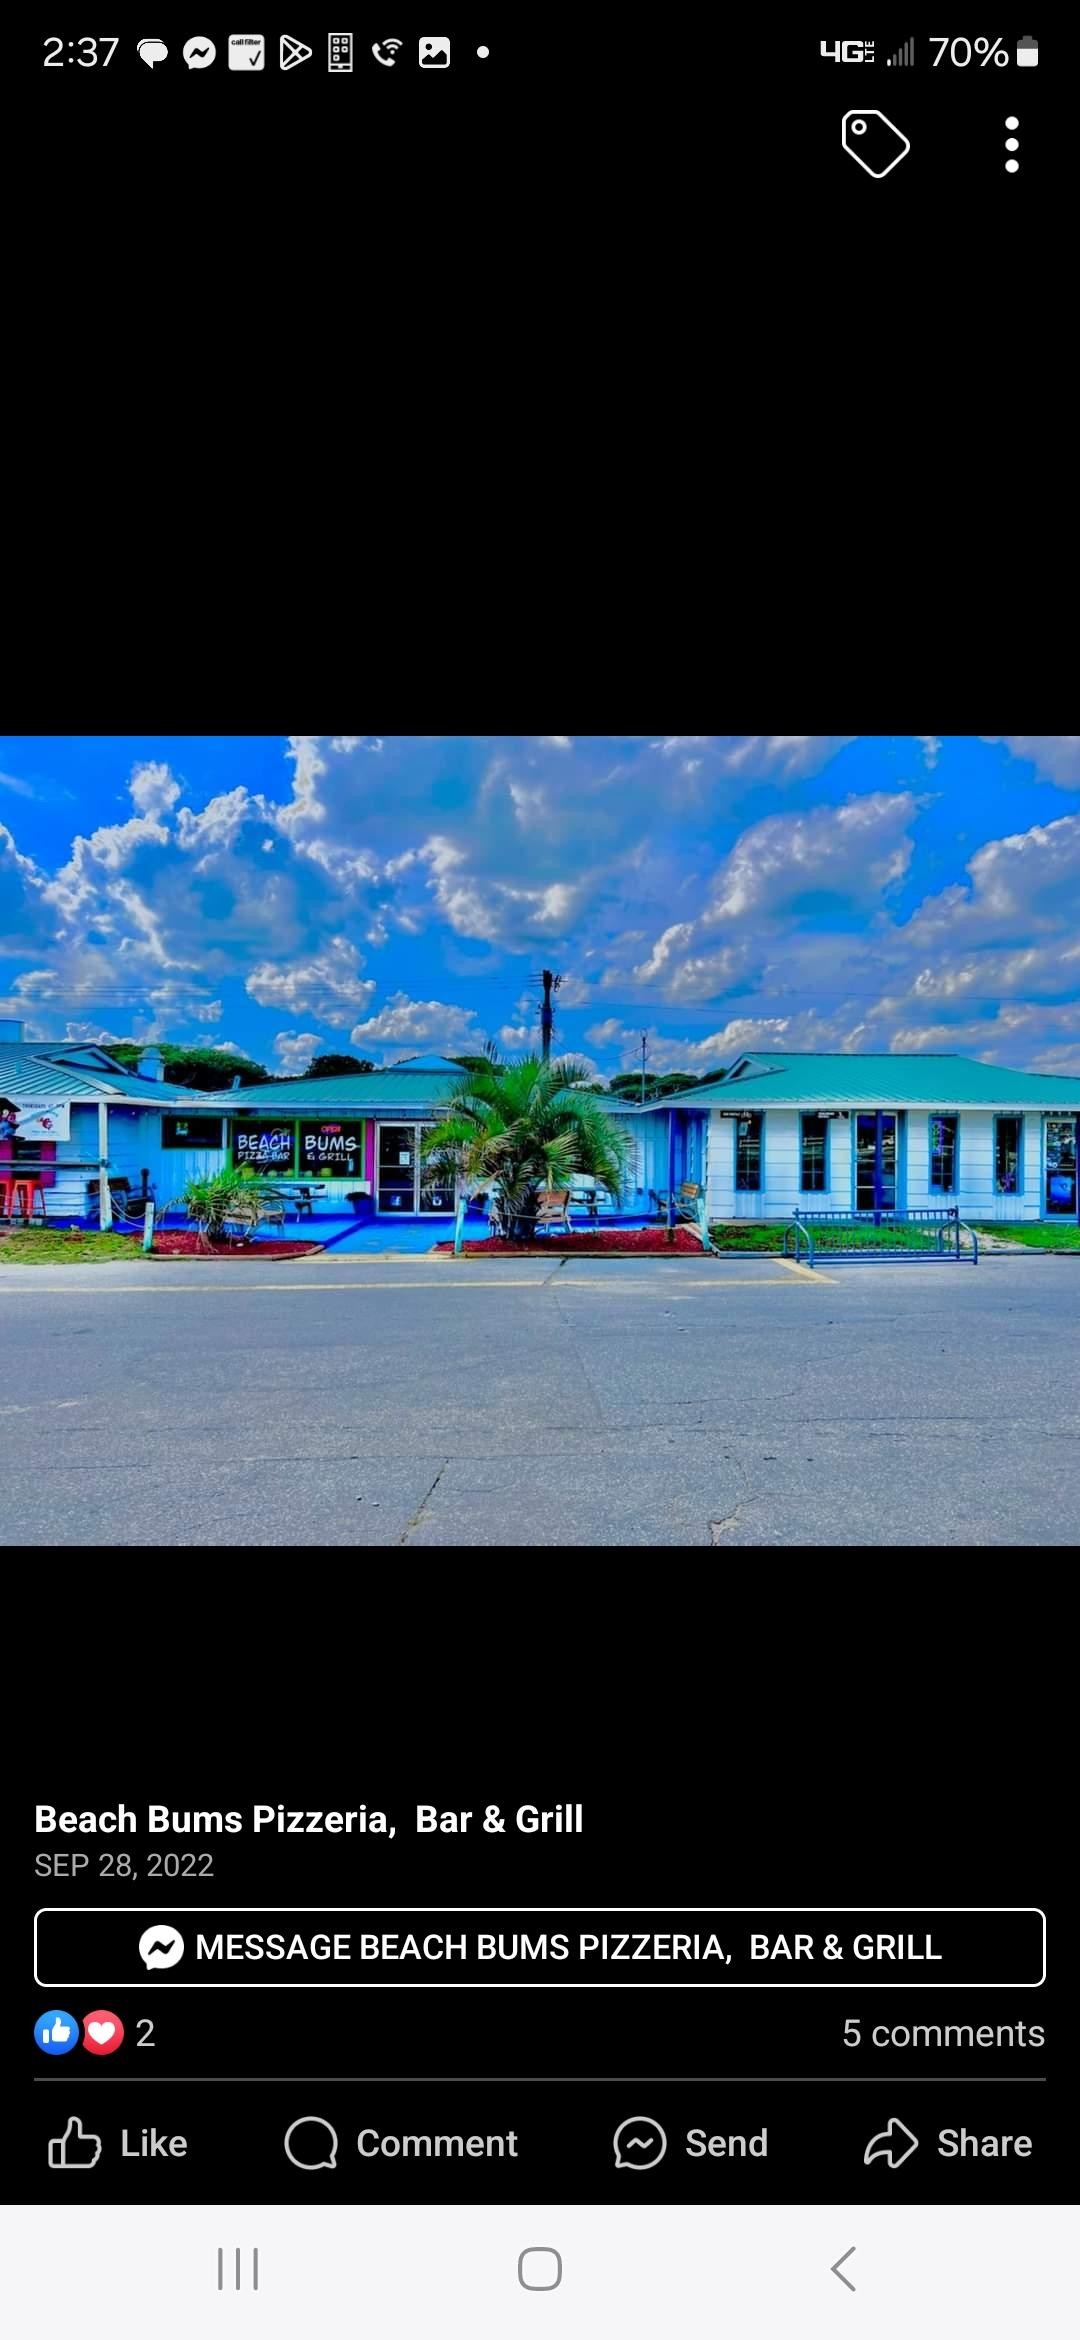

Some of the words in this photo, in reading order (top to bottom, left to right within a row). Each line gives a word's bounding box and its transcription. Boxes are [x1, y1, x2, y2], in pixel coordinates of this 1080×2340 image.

[238, 1134, 291, 1151] BEACH
[304, 1135, 357, 1152] BUMS
[318, 1152, 351, 1161] GRILL
